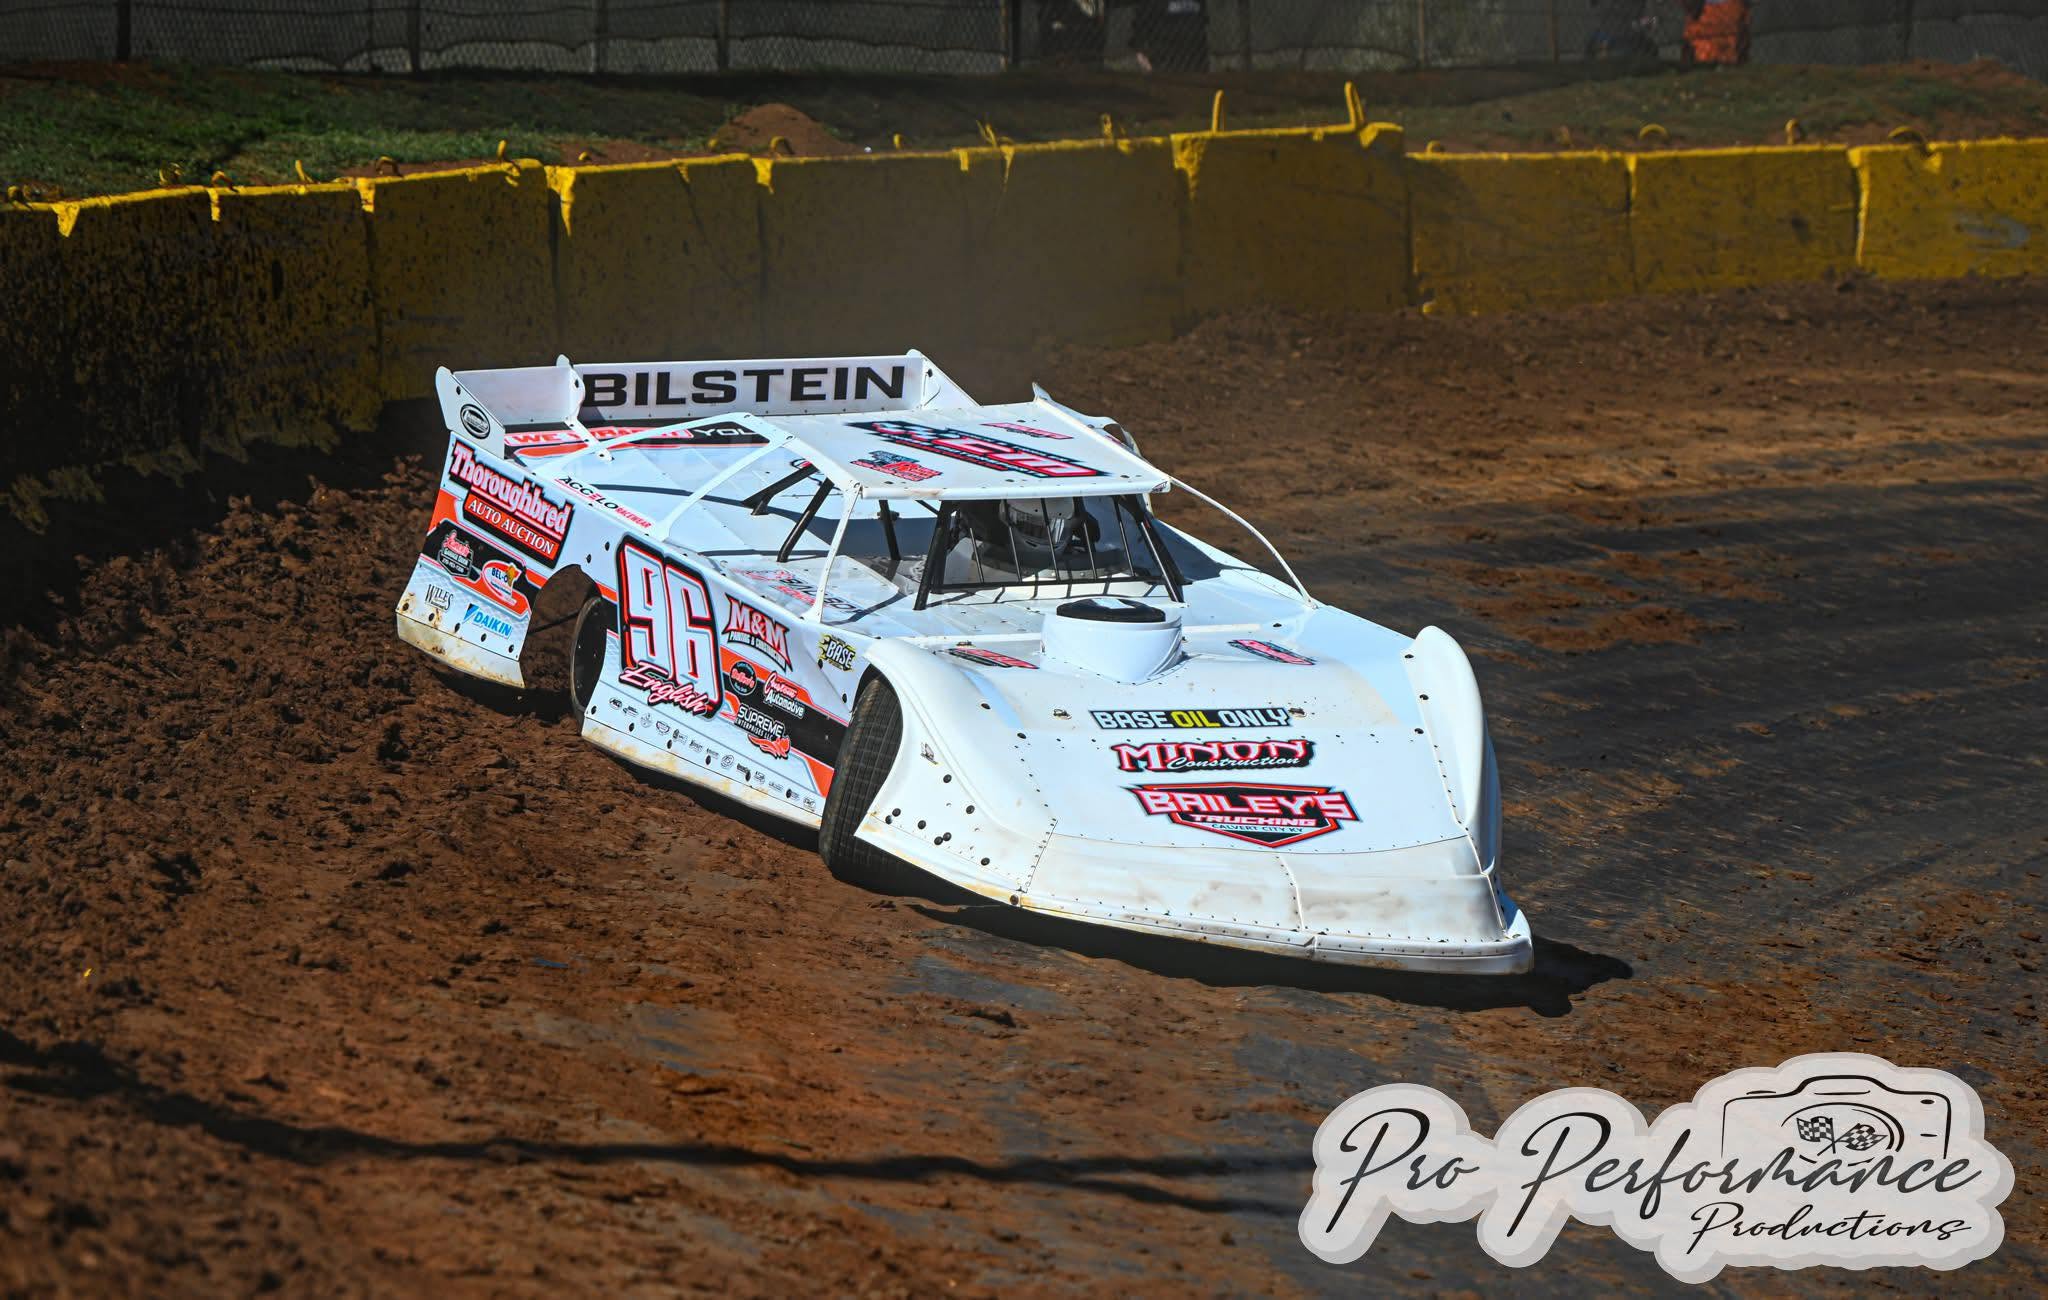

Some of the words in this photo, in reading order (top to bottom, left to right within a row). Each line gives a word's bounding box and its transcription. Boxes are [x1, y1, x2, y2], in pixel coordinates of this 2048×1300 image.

[583, 365, 905, 408] BILSTEIN
[513, 433, 559, 443] WE
[450, 441, 573, 535] Thoroughbred
[558, 476, 618, 509] ACCELO
[468, 499, 501, 524] AUTO
[501, 518, 554, 554] AUCTION
[424, 584, 453, 610] WILES
[473, 611, 512, 638] DAIKIN
[619, 537, 722, 710] 96
[723, 593, 792, 669] M&M
[826, 640, 856, 667] BASE
[619, 660, 708, 712] English
[766, 690, 804, 717] Automotive
[735, 717, 764, 737] ENTERPRISES
[764, 732, 774, 741] LLC
[738, 706, 784, 738] SUPREME
[1093, 710, 1174, 729] BASE
[1171, 710, 1220, 728] OIL
[1217, 708, 1290, 727] ONLY
[1167, 755, 1301, 770] Construction
[1138, 789, 1359, 821] BAILEY'S
[1189, 814, 1317, 827] TRUCKING
[1211, 823, 1258, 832] CALVERT
